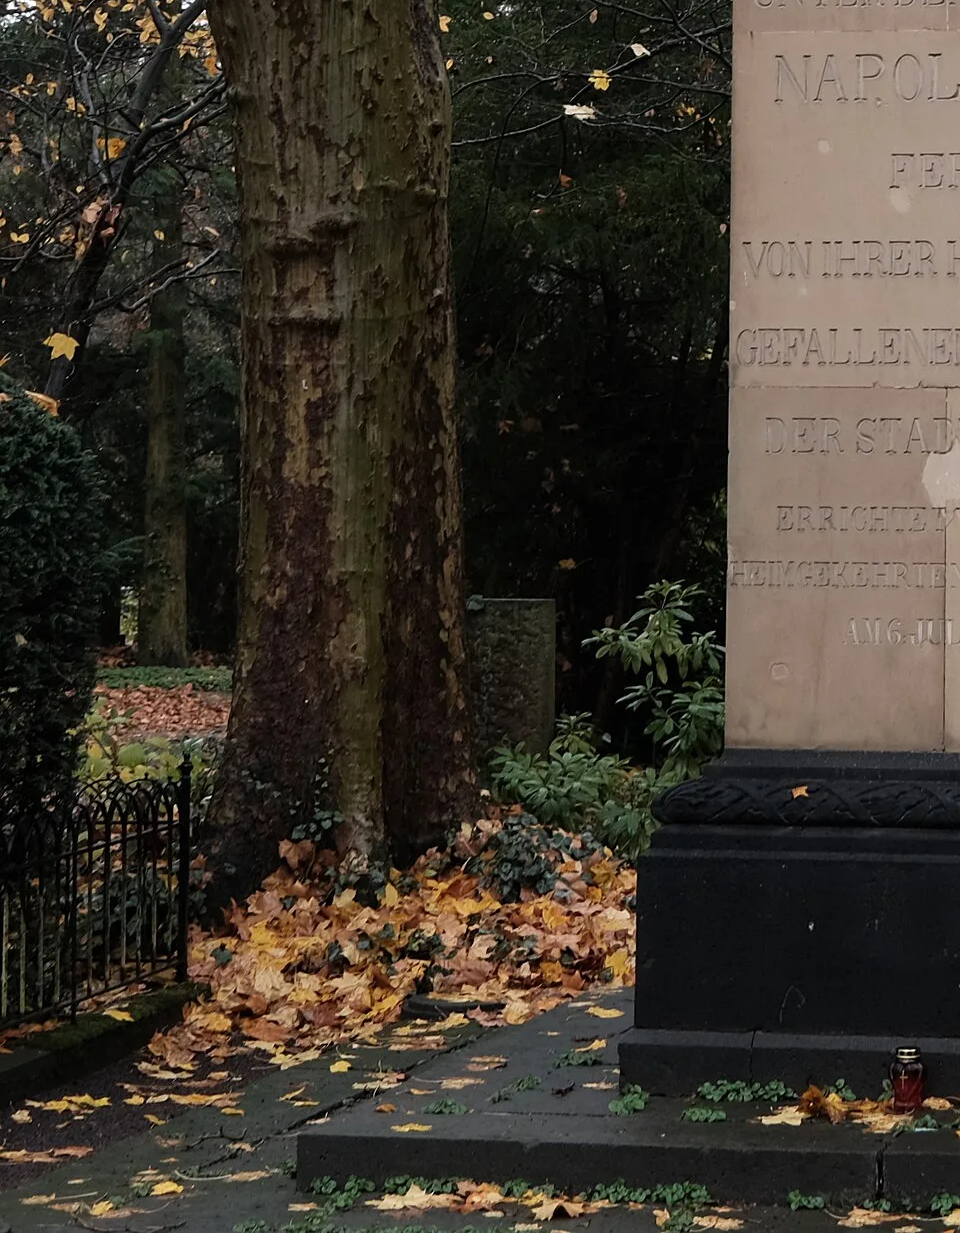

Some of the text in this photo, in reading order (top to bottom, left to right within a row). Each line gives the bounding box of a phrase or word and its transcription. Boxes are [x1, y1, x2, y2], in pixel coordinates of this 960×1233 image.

[742, 241, 812, 278] VON
[822, 240, 937, 278] IHRER
[765, 417, 844, 455] DER
